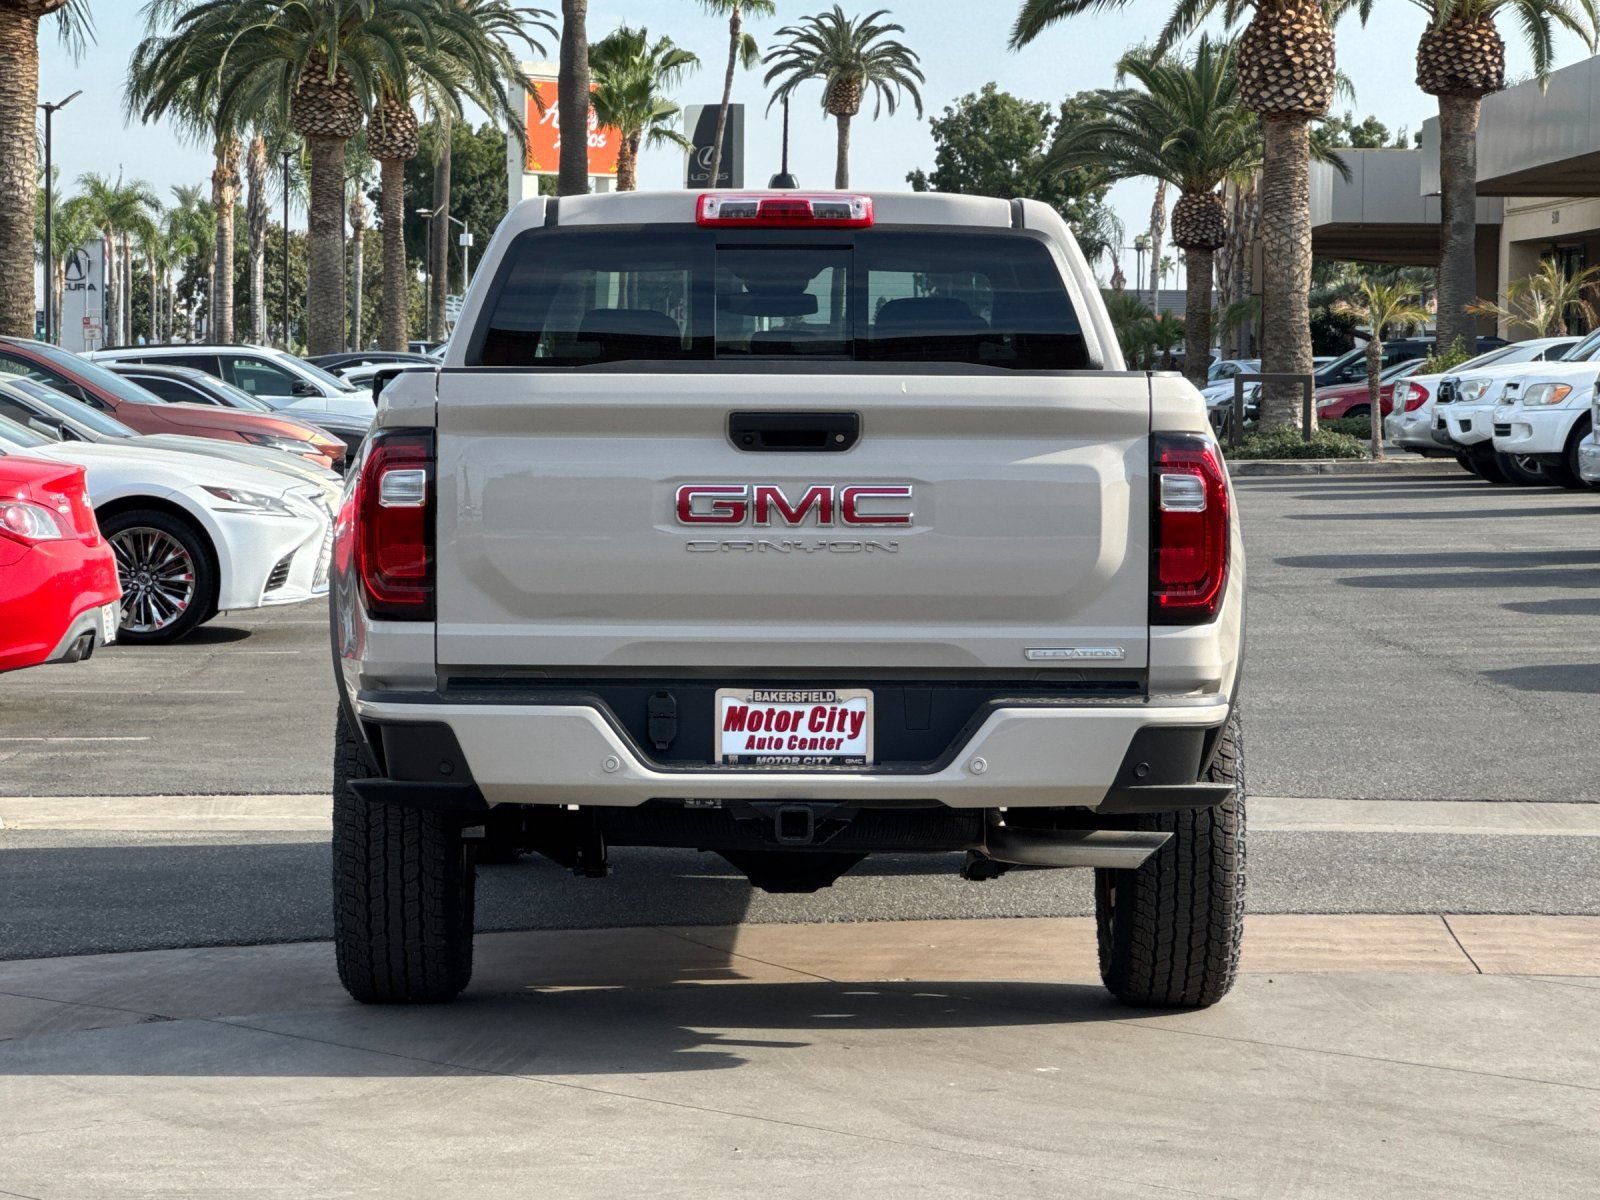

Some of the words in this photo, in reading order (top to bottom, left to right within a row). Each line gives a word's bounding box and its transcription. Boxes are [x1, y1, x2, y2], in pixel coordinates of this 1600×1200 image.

[690, 172, 729, 181] LEXS
[676, 484, 912, 527] GMC
[686, 540, 899, 553] CANYON
[1030, 648, 1119, 658] ELEVATION
[754, 691, 835, 702] BAKERSFIELD
[723, 705, 805, 732] Motor
[807, 706, 866, 739] City
[745, 735, 784, 750] Auto
[787, 735, 844, 750] Center
[756, 756, 800, 765] MOTOR
[803, 757, 833, 765] CITY
